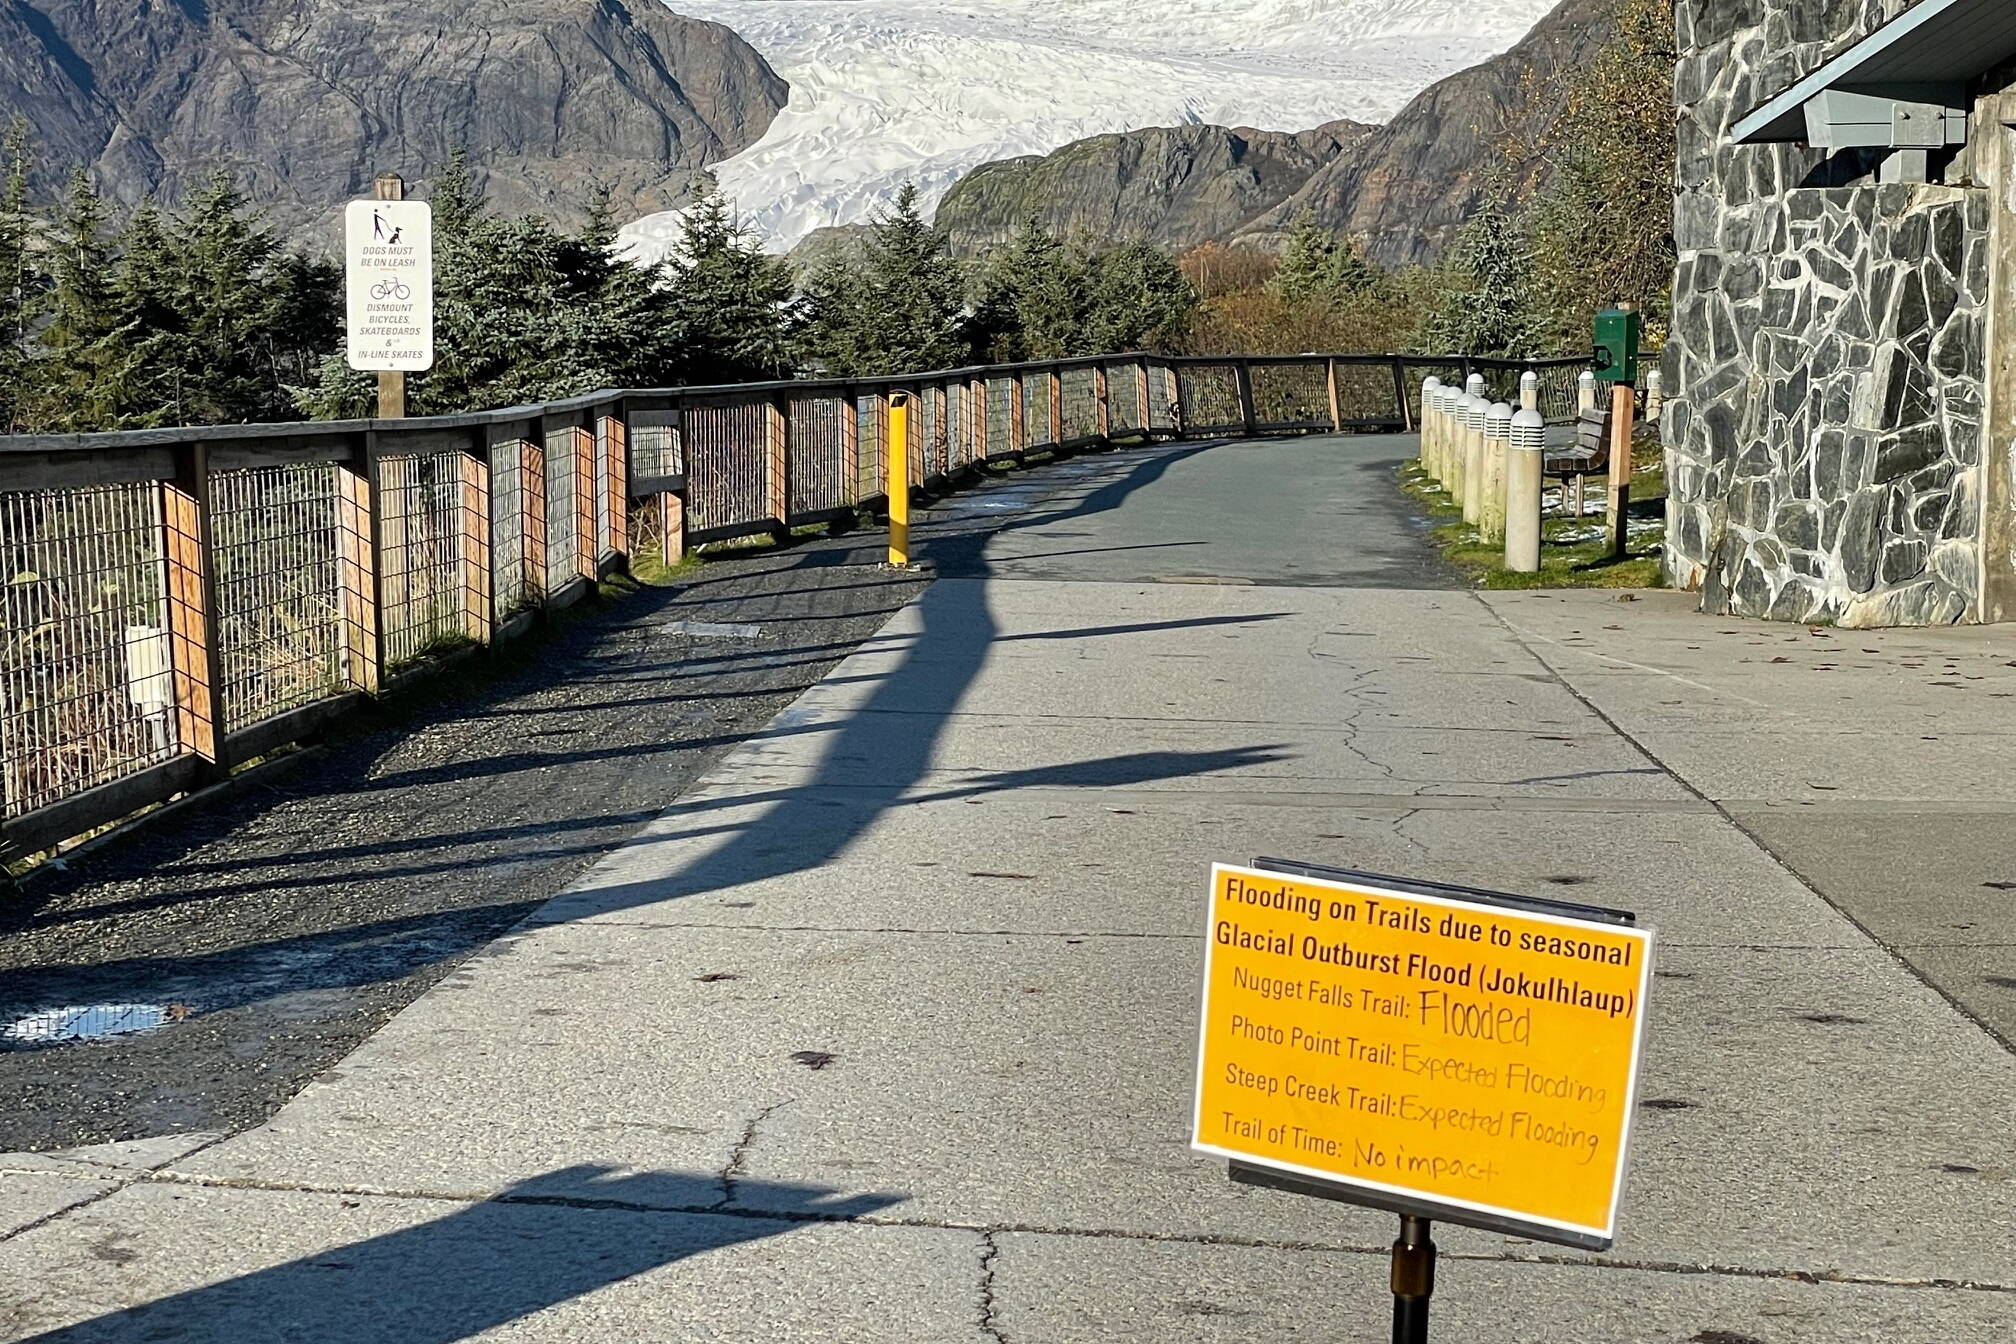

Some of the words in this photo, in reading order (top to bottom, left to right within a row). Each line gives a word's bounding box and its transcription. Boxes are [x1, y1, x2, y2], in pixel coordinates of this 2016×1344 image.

[363, 247, 386, 255] DOGS
[388, 247, 413, 255] MUST
[386, 339, 392, 347] &
[1226, 879, 1321, 921] Flooding
[1330, 903, 1356, 922] on
[1365, 901, 1432, 933] Trails
[1440, 916, 1482, 942] due
[1491, 925, 1511, 947] to
[1519, 930, 1631, 965] seasonal
[1217, 922, 1294, 958] Glacial
[1302, 937, 1400, 975] Outburst
[1407, 954, 1472, 986] Flood
[1479, 965, 1635, 1018] (Jokulhlaup)
[1233, 966, 1303, 1001] Nugget
[1309, 981, 1353, 1009] Falls
[1361, 990, 1410, 1018] Trail:
[1231, 1016, 1284, 1045] Photo
[1291, 1027, 1341, 1056] Point
[1348, 1038, 1396, 1066] Trail:
[1418, 990, 1532, 1047] Flooded
[1226, 1063, 1278, 1096] Steep
[1285, 1075, 1340, 1106] Creek
[1347, 1088, 1396, 1116] Trail:
[1403, 1045, 1496, 1088] Expected
[1506, 1064, 1606, 1113] Flooding
[1222, 1112, 1262, 1139] Trail
[1268, 1123, 1287, 1145] of
[1291, 1128, 1342, 1157] Time:
[1399, 1095, 1503, 1136] Expected
[1509, 1113, 1599, 1165] Flooding
[1353, 1138, 1386, 1168] No
[1396, 1145, 1498, 1183] impact
